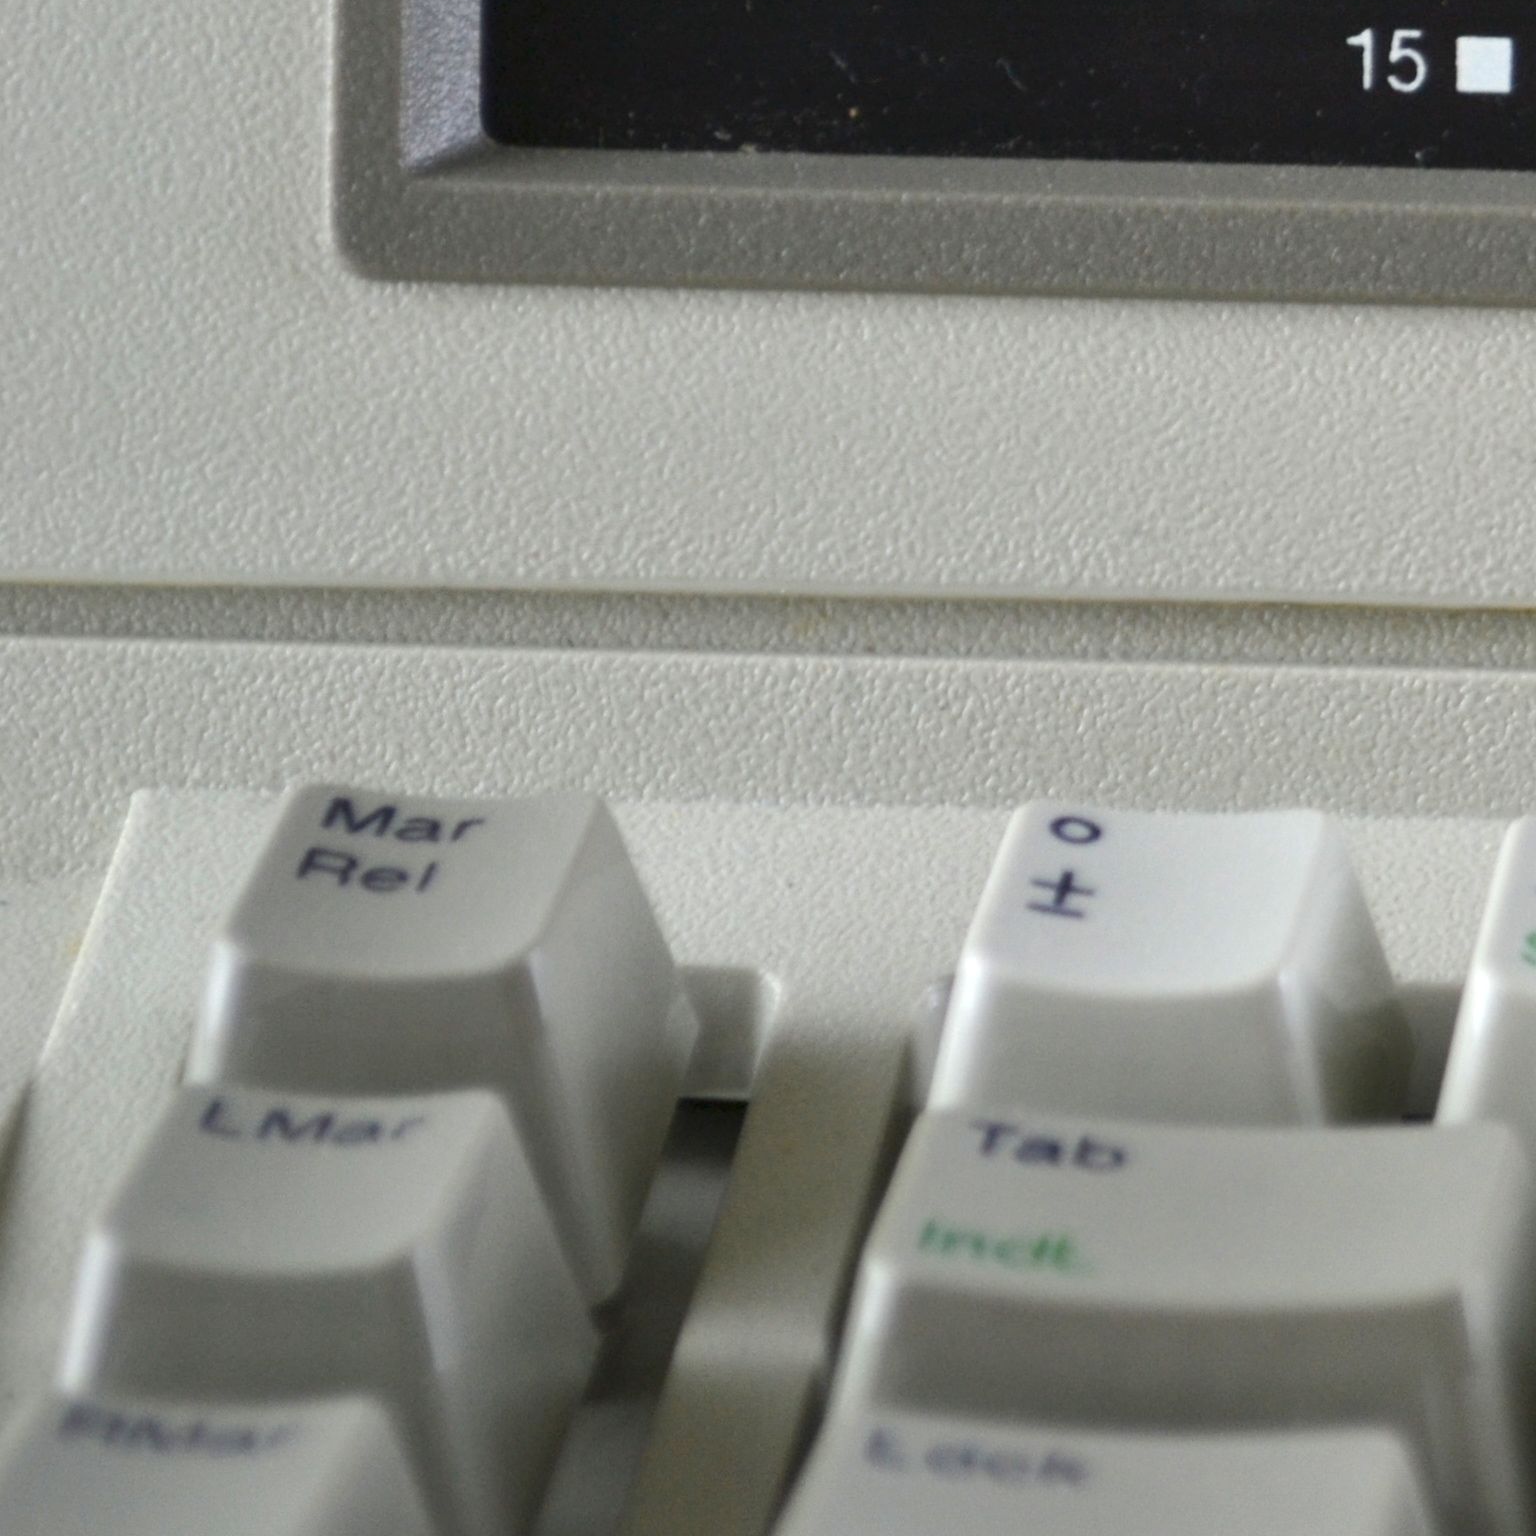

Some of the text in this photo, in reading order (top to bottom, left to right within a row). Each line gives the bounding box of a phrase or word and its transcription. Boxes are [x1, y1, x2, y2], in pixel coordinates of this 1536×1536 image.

[1346, 28, 1427, 93] 15
[322, 796, 486, 843] Mar
[296, 846, 438, 893] Rel
[200, 1096, 426, 1146] LMar
[970, 1119, 1129, 1176] Tab
